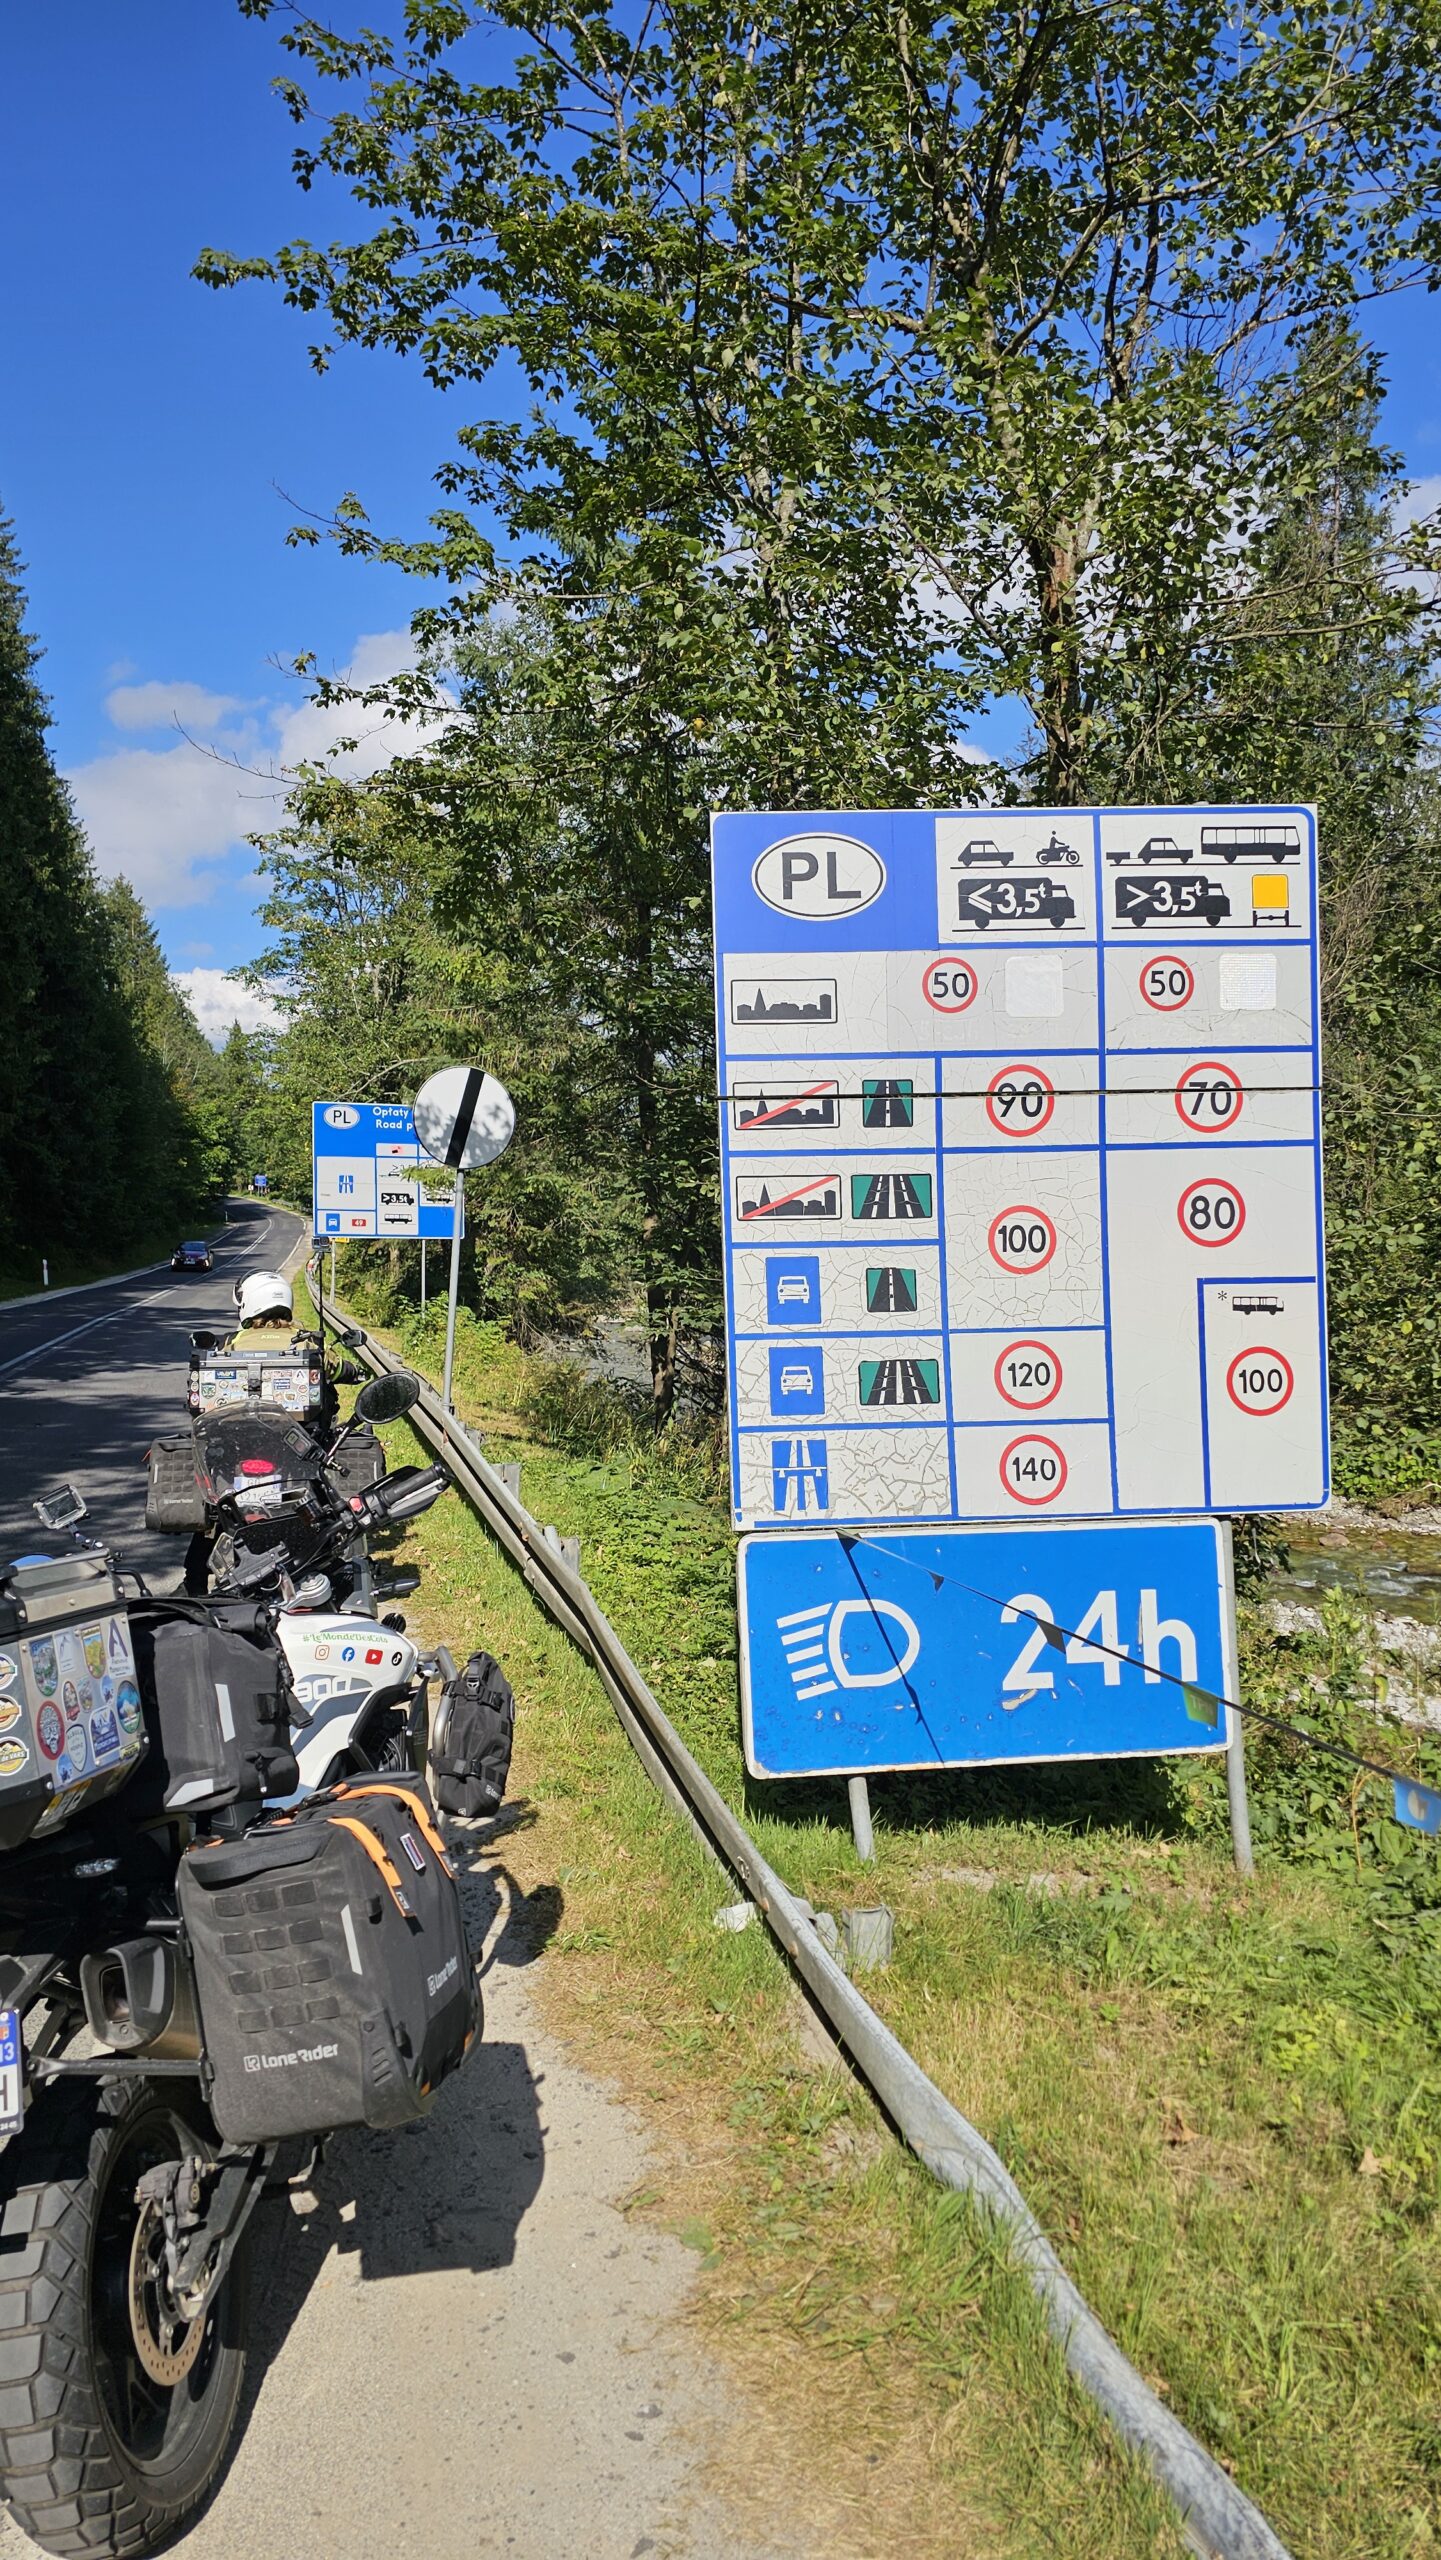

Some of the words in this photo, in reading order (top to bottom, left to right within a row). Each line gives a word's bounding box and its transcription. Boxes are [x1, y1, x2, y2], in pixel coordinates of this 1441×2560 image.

[781, 851, 862, 900] PL
[932, 972, 970, 999] 50
[1150, 969, 1186, 997] 50
[996, 1082, 1043, 1118] 90
[1187, 1080, 1232, 1116] 70
[333, 1109, 351, 1124] PL
[373, 1106, 409, 1119] Opłaty
[375, 1119, 403, 1129] Road
[1189, 1195, 1236, 1230] 80
[997, 1224, 1047, 1254] 100
[1007, 1361, 1051, 1388] 120
[1238, 1368, 1283, 1394] 100
[1012, 1456, 1057, 1482] 140
[1000, 1589, 1198, 1690] 24h
